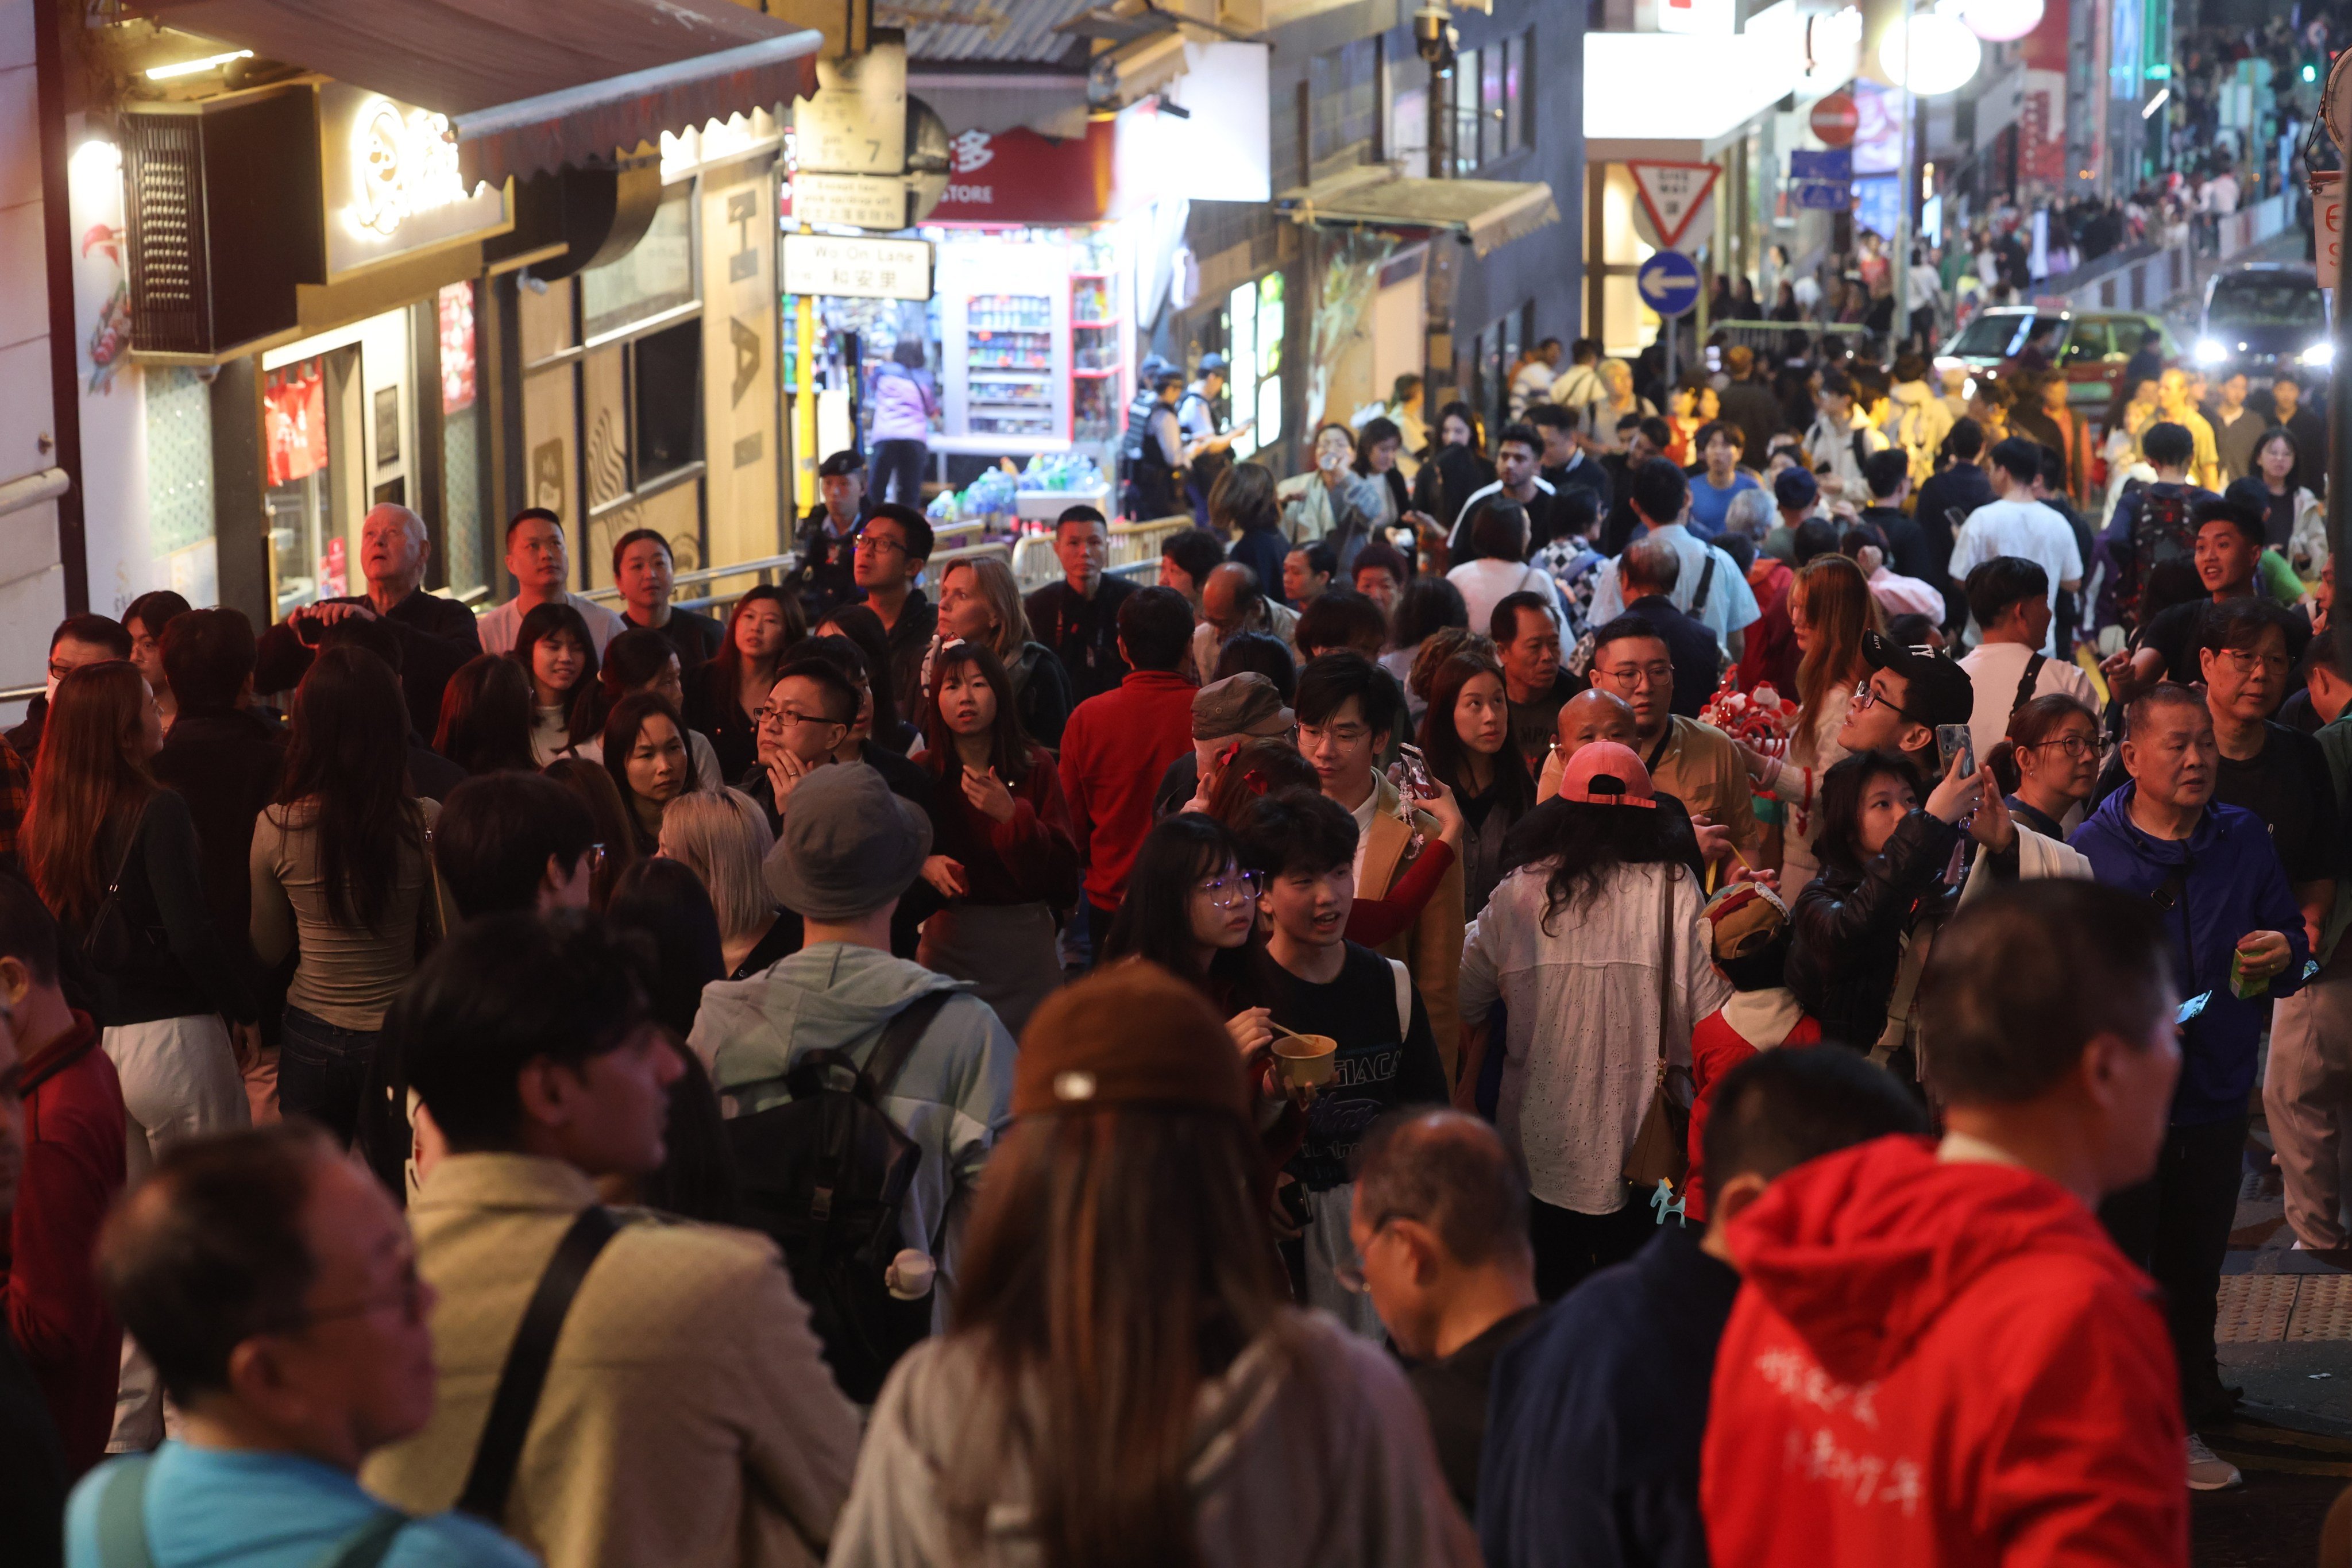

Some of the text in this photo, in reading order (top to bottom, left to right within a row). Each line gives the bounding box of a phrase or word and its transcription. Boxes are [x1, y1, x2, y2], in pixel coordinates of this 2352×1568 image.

[864, 138, 882, 163] 7
[814, 245, 915, 264] Wo On Lane
[832, 268, 898, 289] 和安里
